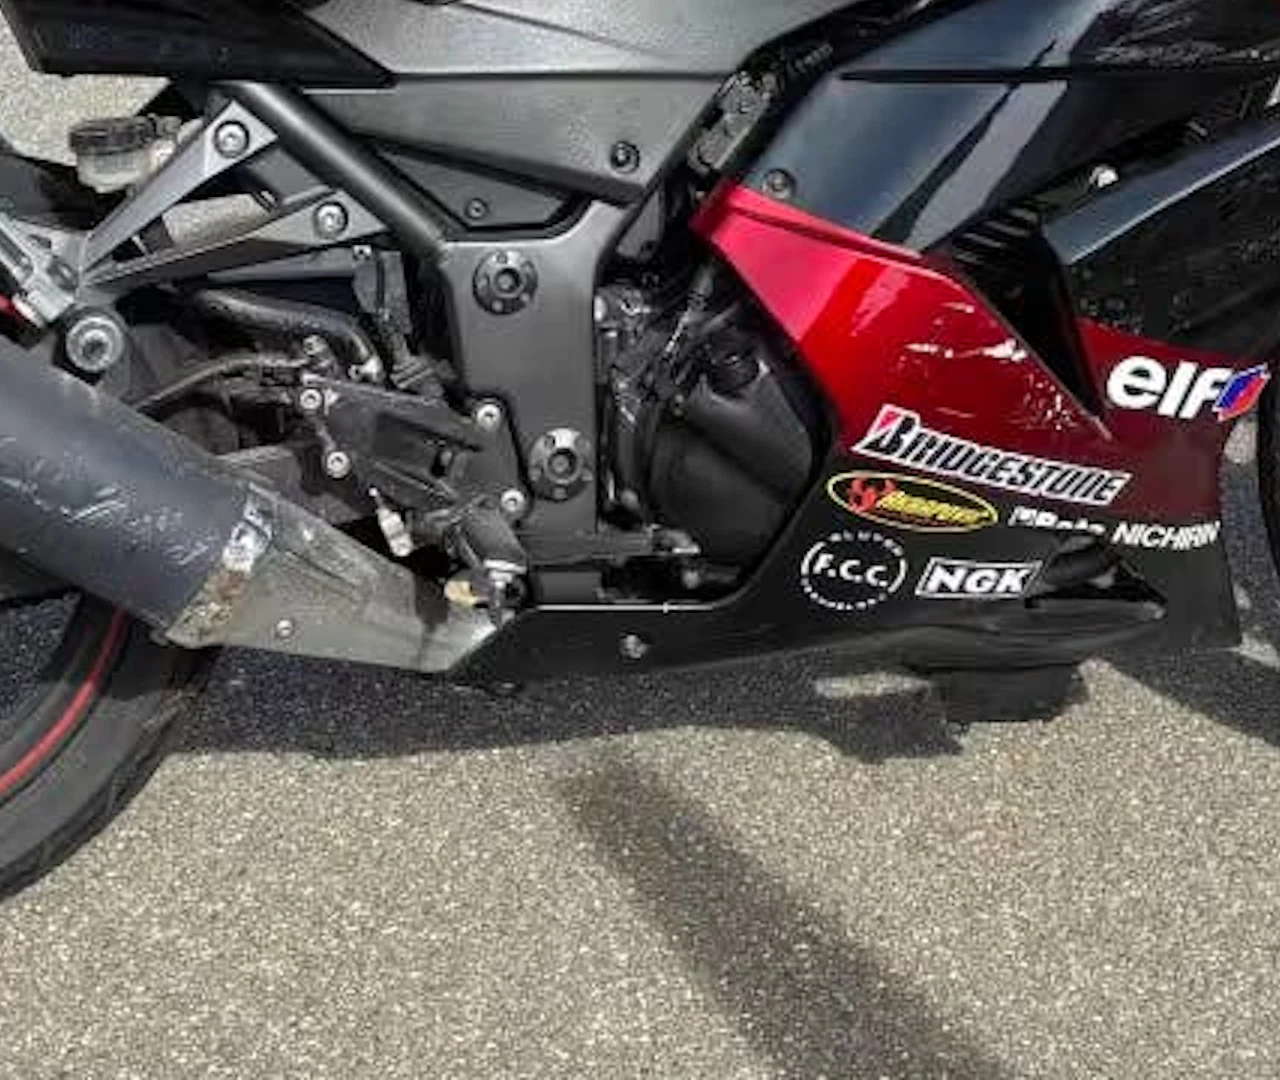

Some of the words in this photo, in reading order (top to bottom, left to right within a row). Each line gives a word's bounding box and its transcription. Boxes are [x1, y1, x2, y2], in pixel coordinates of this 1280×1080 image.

[1106, 355, 1235, 419] elf
[860, 414, 1125, 503] BRIDGESTONE
[813, 553, 888, 587] F.C.C.
[926, 565, 1031, 593] NGK
